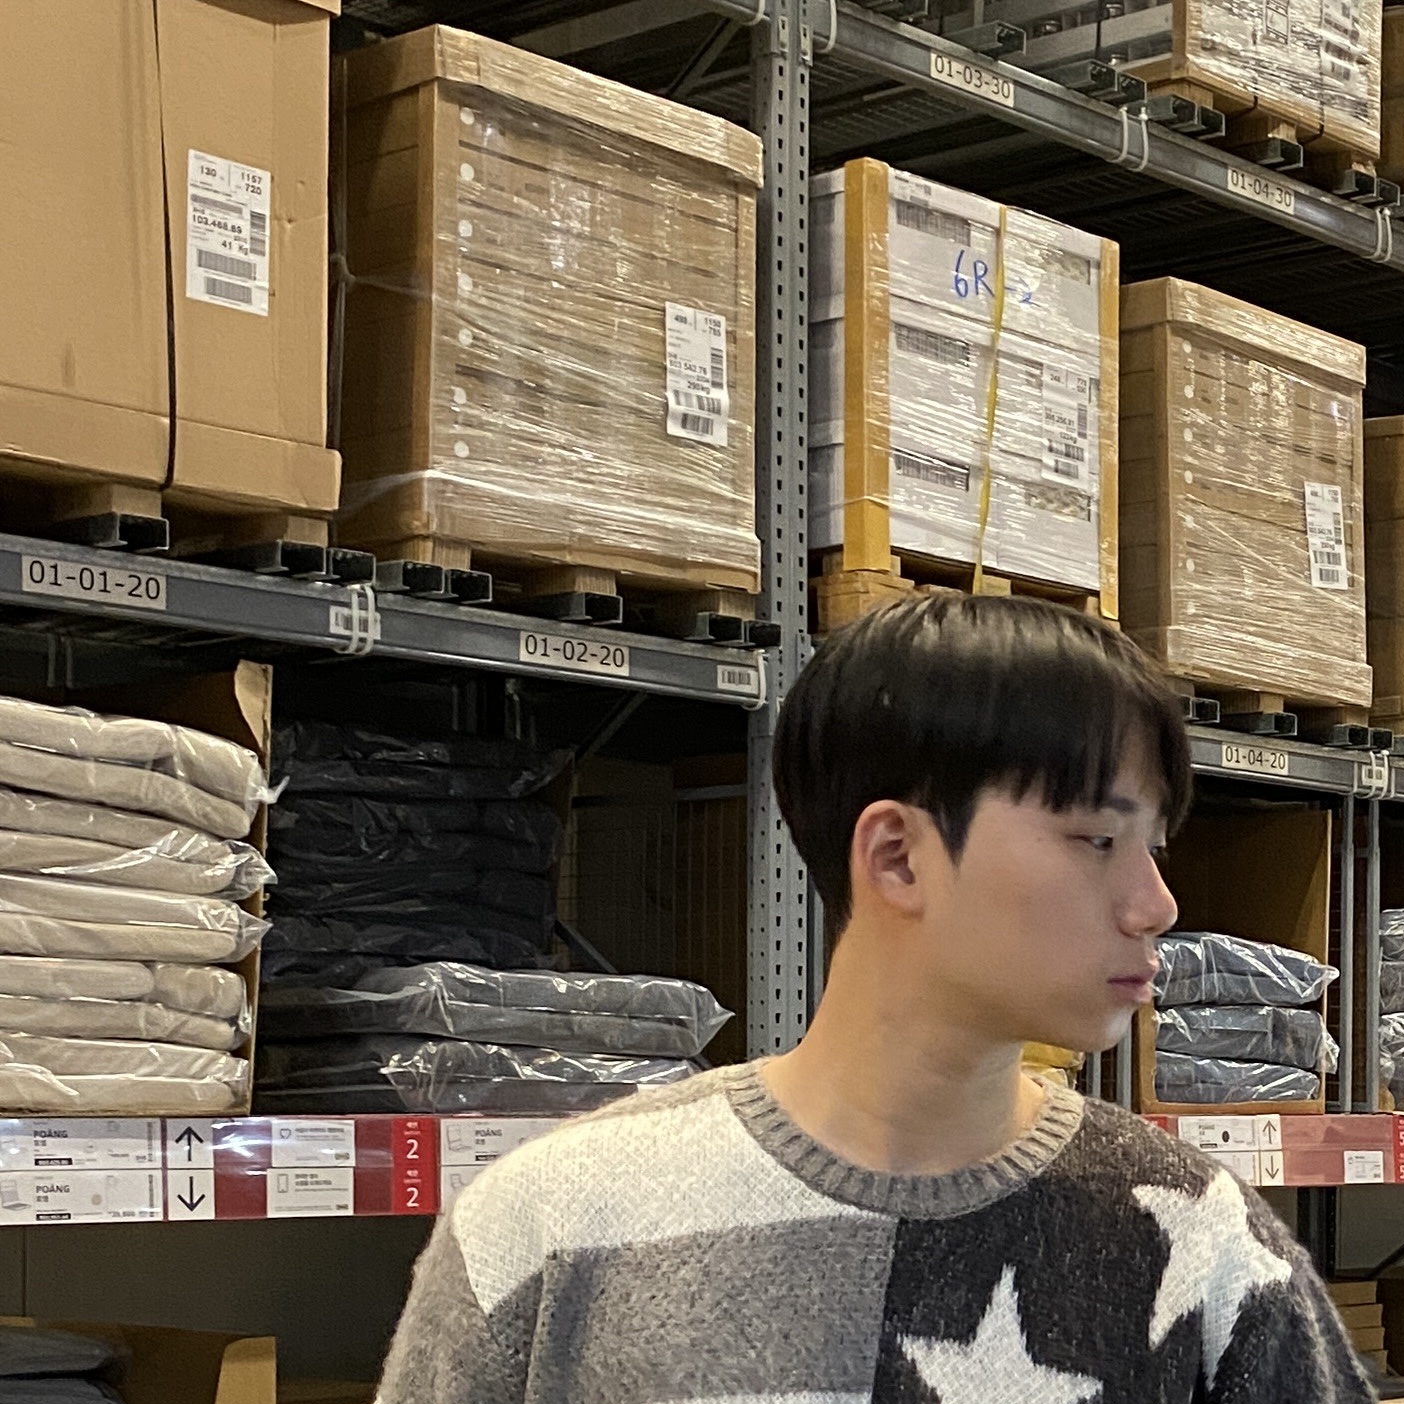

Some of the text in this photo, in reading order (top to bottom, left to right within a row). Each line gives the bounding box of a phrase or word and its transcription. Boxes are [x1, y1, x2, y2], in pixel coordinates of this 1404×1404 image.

[935, 55, 1010, 99] 01-03-30
[1231, 169, 1291, 207] 01-04-30
[29, 560, 160, 600] 01-01-20
[525, 634, 625, 668] 01-02-20
[1225, 745, 1286, 770] 01-04-20
[406, 1138, 420, 1160] 2
[406, 1187, 420, 1208] 2
